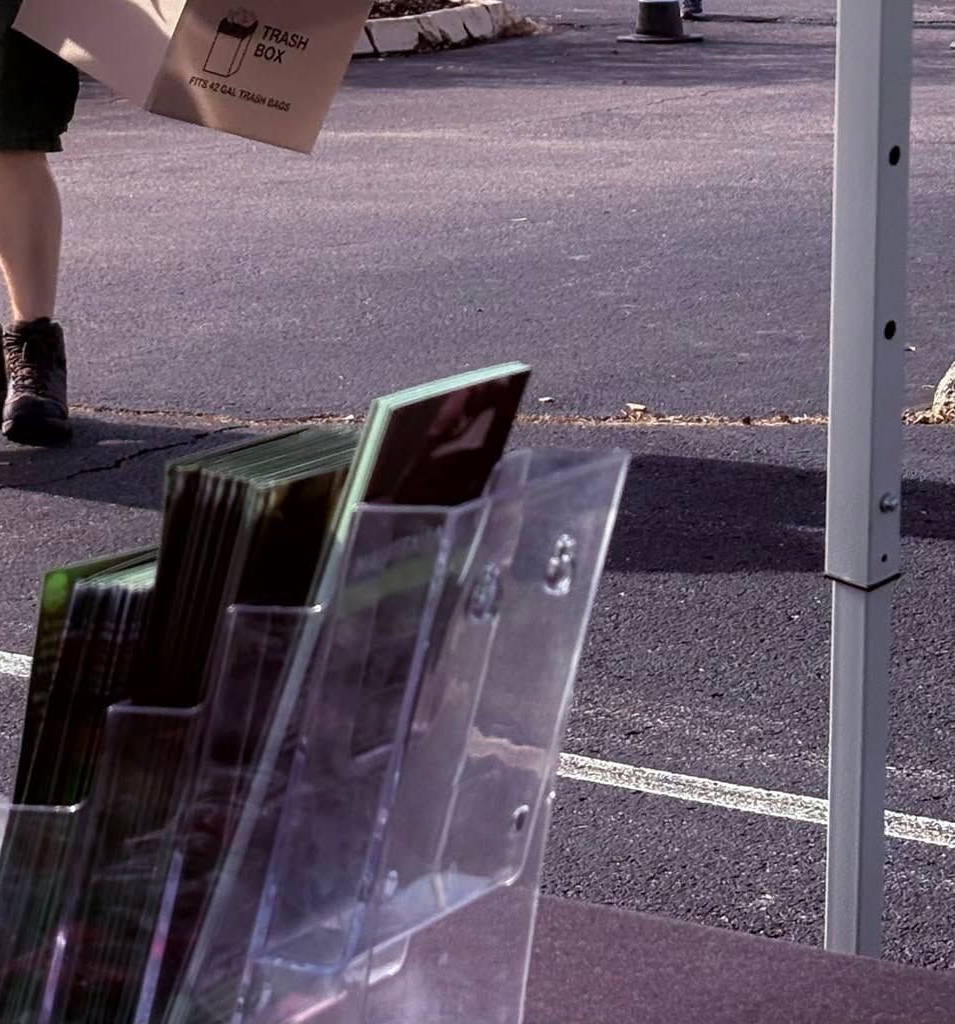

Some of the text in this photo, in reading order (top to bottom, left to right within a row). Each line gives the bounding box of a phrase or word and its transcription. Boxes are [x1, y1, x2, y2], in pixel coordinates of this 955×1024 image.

[262, 25, 309, 50] TRASH
[254, 43, 285, 64] BOX
[189, 76, 291, 112] FITS 42 GAL TRASH BAGS
